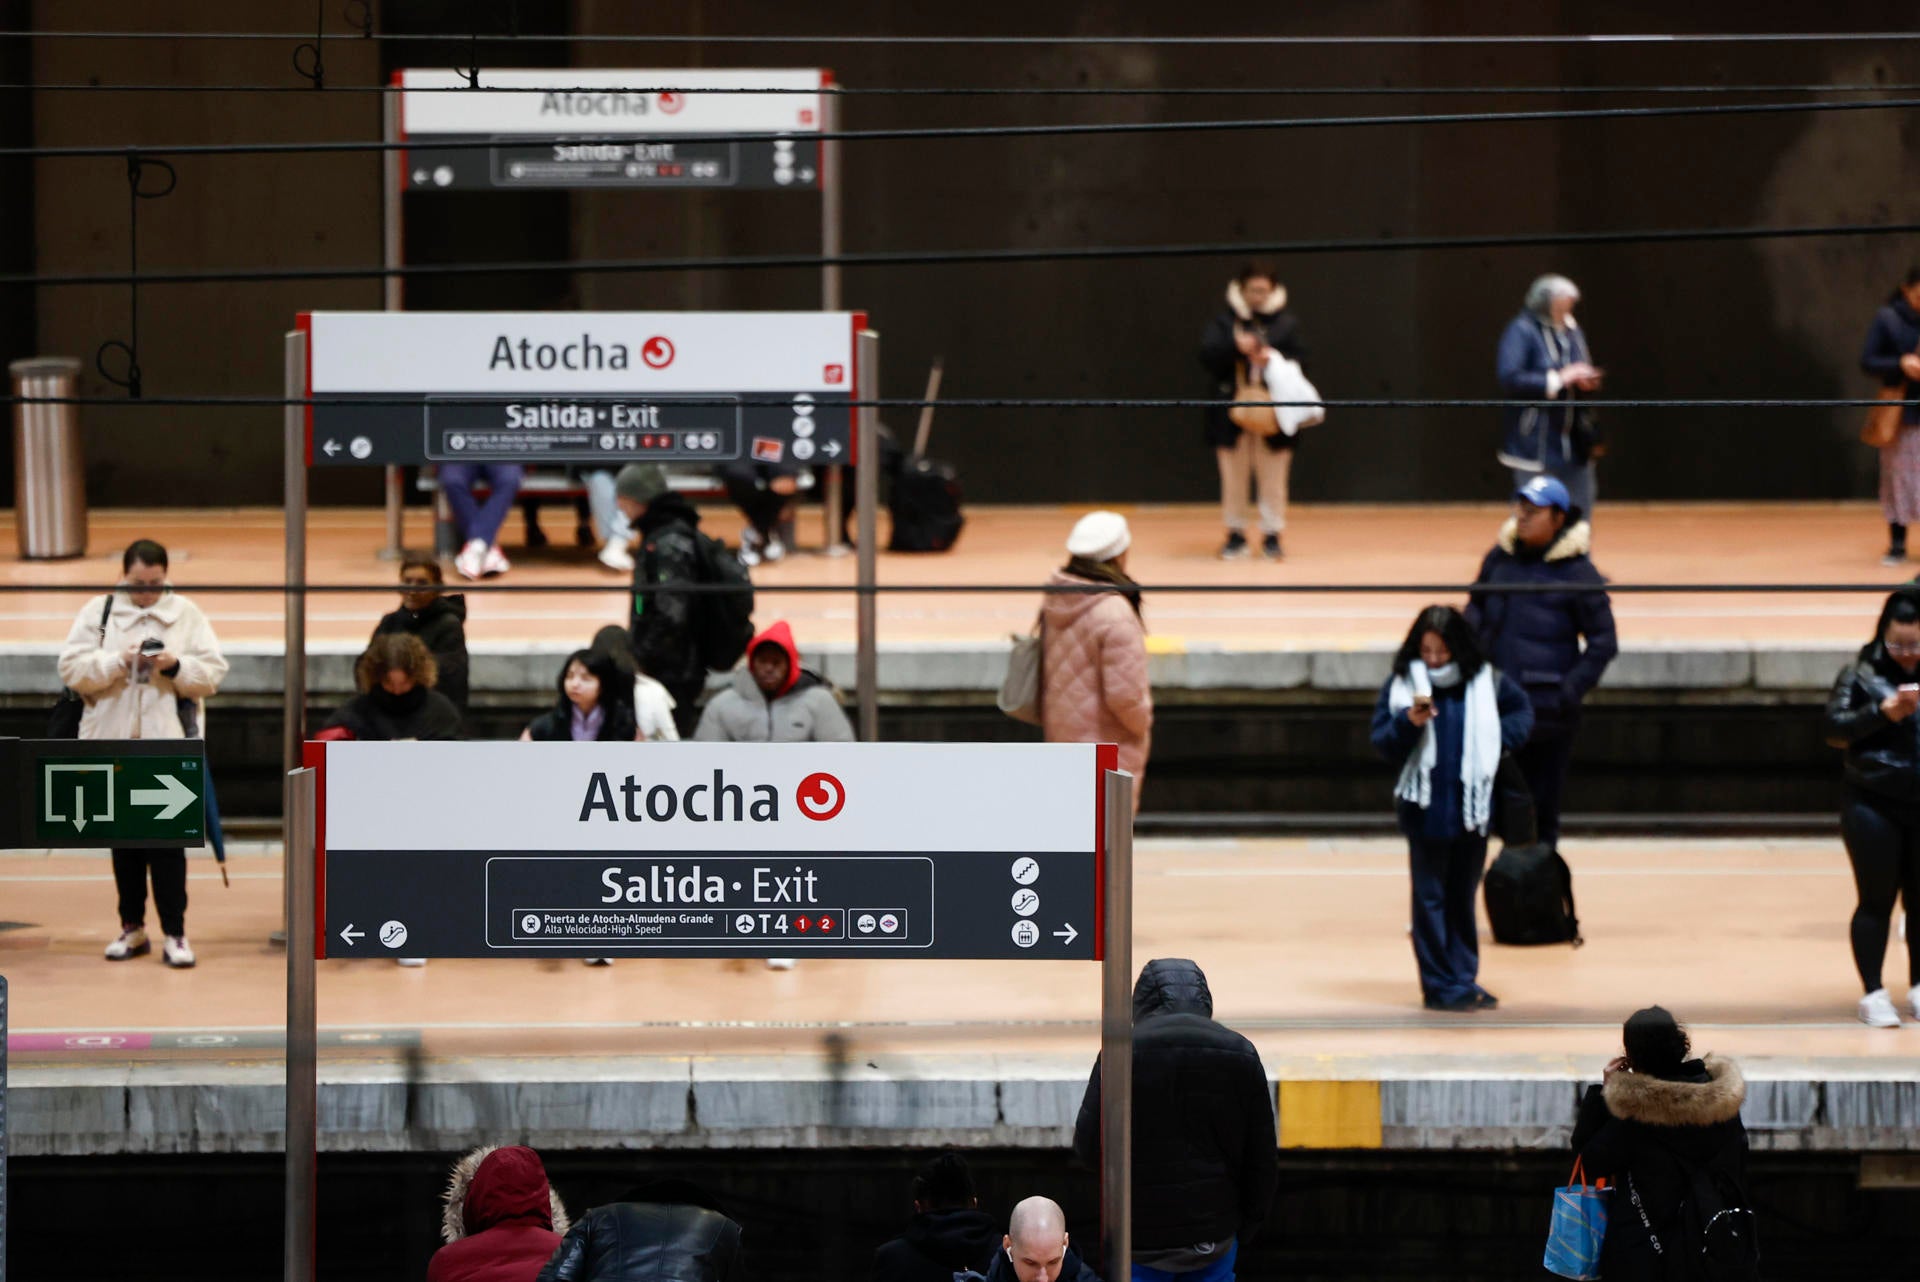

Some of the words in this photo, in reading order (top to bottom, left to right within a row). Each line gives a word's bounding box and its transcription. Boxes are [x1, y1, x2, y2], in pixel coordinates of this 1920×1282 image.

[541, 89, 649, 116] Atocha
[490, 334, 629, 370] Atocha
[505, 402, 595, 429] Salida
[611, 403, 660, 429] Exit
[579, 769, 779, 823] Atocha
[601, 866, 725, 903] Salida
[753, 867, 818, 903] Exit
[544, 914, 576, 924] Puerta
[578, 914, 590, 924] de
[592, 914, 676, 924] Atocha-Almudena
[679, 914, 714, 924] Grande
[544, 925, 562, 934] Alta
[635, 924, 662, 936] Speed
[799, 918, 805, 930] 1
[821, 918, 830, 930] 2
